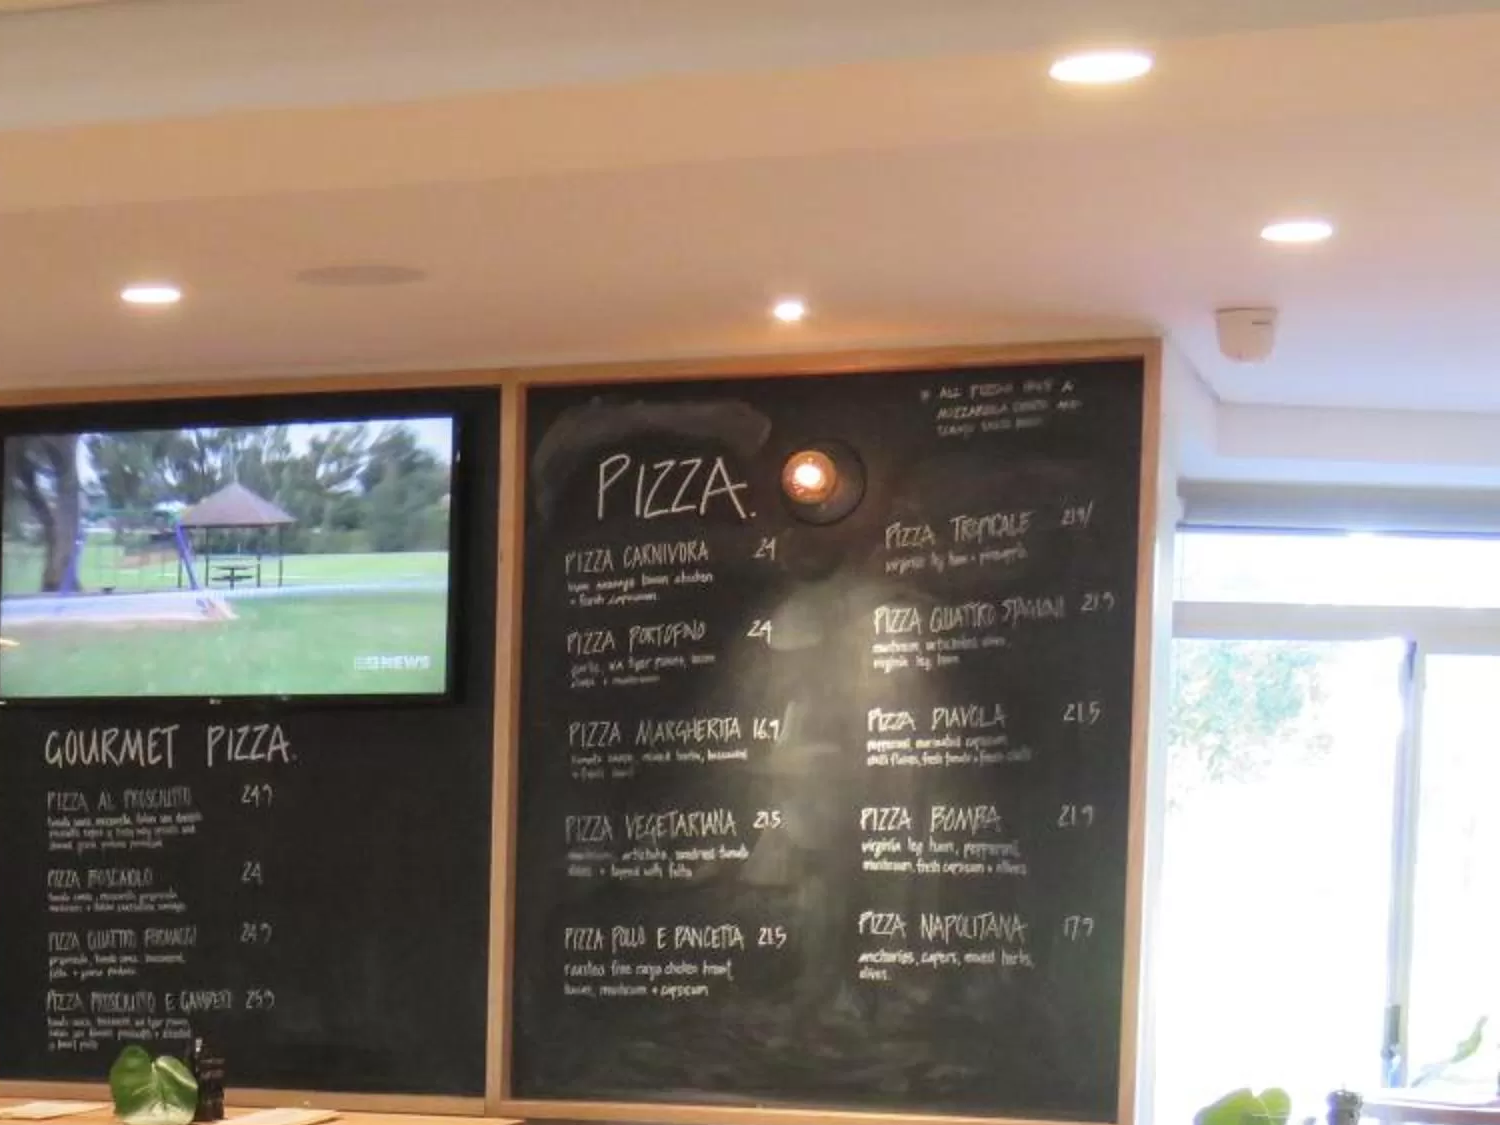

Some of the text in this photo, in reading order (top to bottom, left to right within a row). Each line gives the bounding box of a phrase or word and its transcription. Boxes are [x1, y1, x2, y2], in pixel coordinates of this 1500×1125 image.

[597, 453, 756, 520] PIZZA.
[885, 521, 937, 550] PIZZA
[948, 510, 1036, 545] TROPICALE
[565, 548, 615, 575] PIZZA
[623, 539, 709, 569] CARNIVORA
[873, 604, 923, 636] PIZZA
[567, 630, 617, 655] PIZZA
[746, 619, 773, 645] 24
[568, 719, 622, 748] PIZZA
[635, 716, 741, 747] MARGHERITA
[867, 707, 917, 732] PIZZA
[44, 724, 181, 769] GOURMET
[47, 789, 89, 813] PIZZA
[565, 814, 614, 844] PIZZA
[624, 807, 737, 843] VEGETARIANA
[859, 805, 913, 832] PIZZA
[929, 803, 1003, 836] BOMBA
[47, 868, 81, 890] PIZZA
[48, 930, 81, 952] PIZZA
[564, 926, 604, 951] PIZZA
[610, 924, 646, 954] POLLO
[656, 926, 669, 949] E
[674, 922, 745, 951] PANCETTA
[858, 909, 908, 939] PIZZA
[919, 911, 1029, 946] NAPOLITANA
[46, 989, 84, 1011] PIZZA
